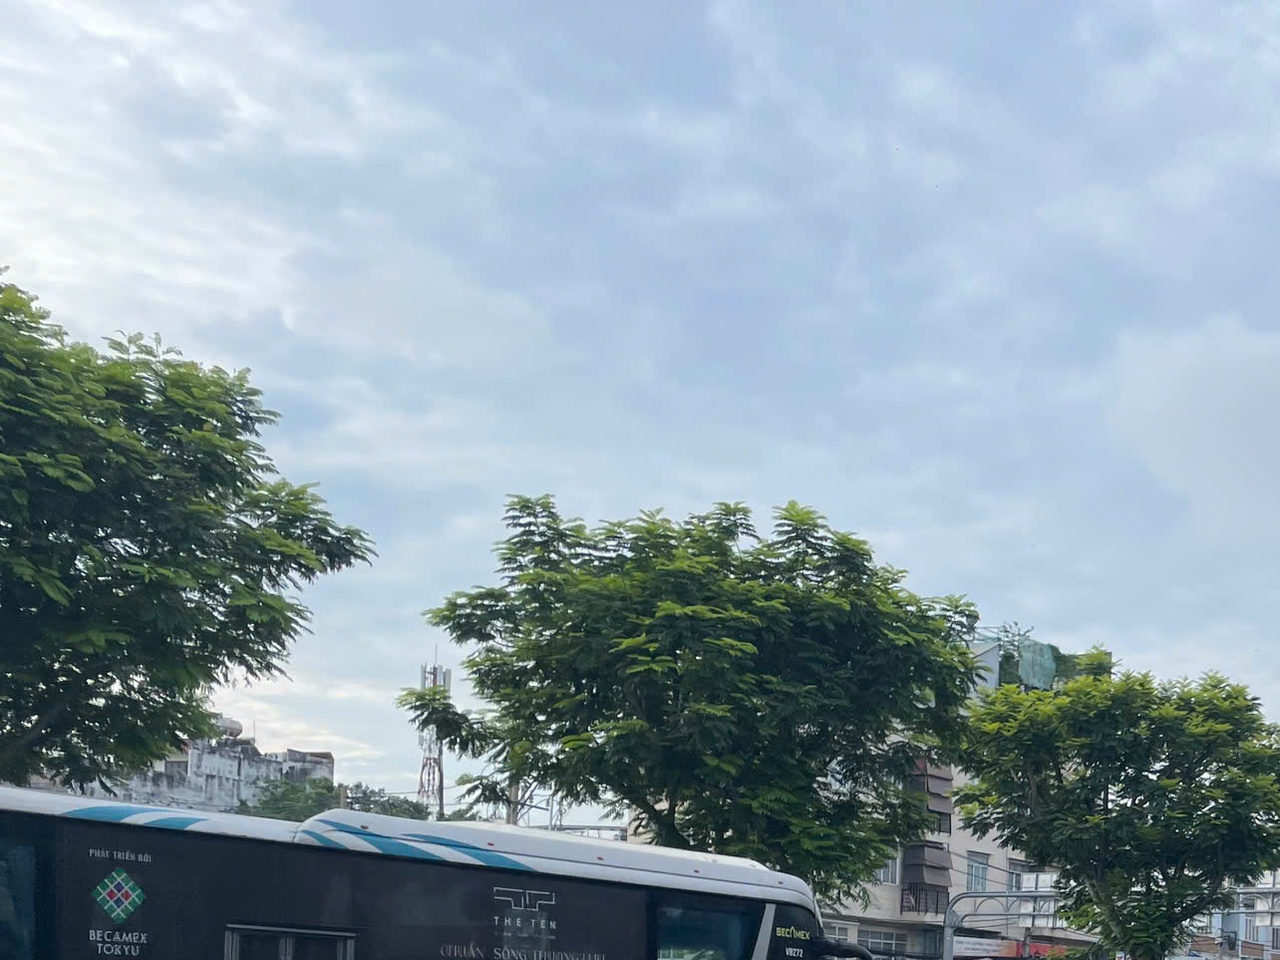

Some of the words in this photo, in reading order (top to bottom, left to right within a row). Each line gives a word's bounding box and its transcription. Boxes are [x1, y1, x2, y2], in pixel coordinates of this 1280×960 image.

[494, 915, 522, 928] THE
[531, 918, 557, 930] TEN
[89, 929, 148, 944] BECAMEX
[97, 943, 140, 956] TOKYU
